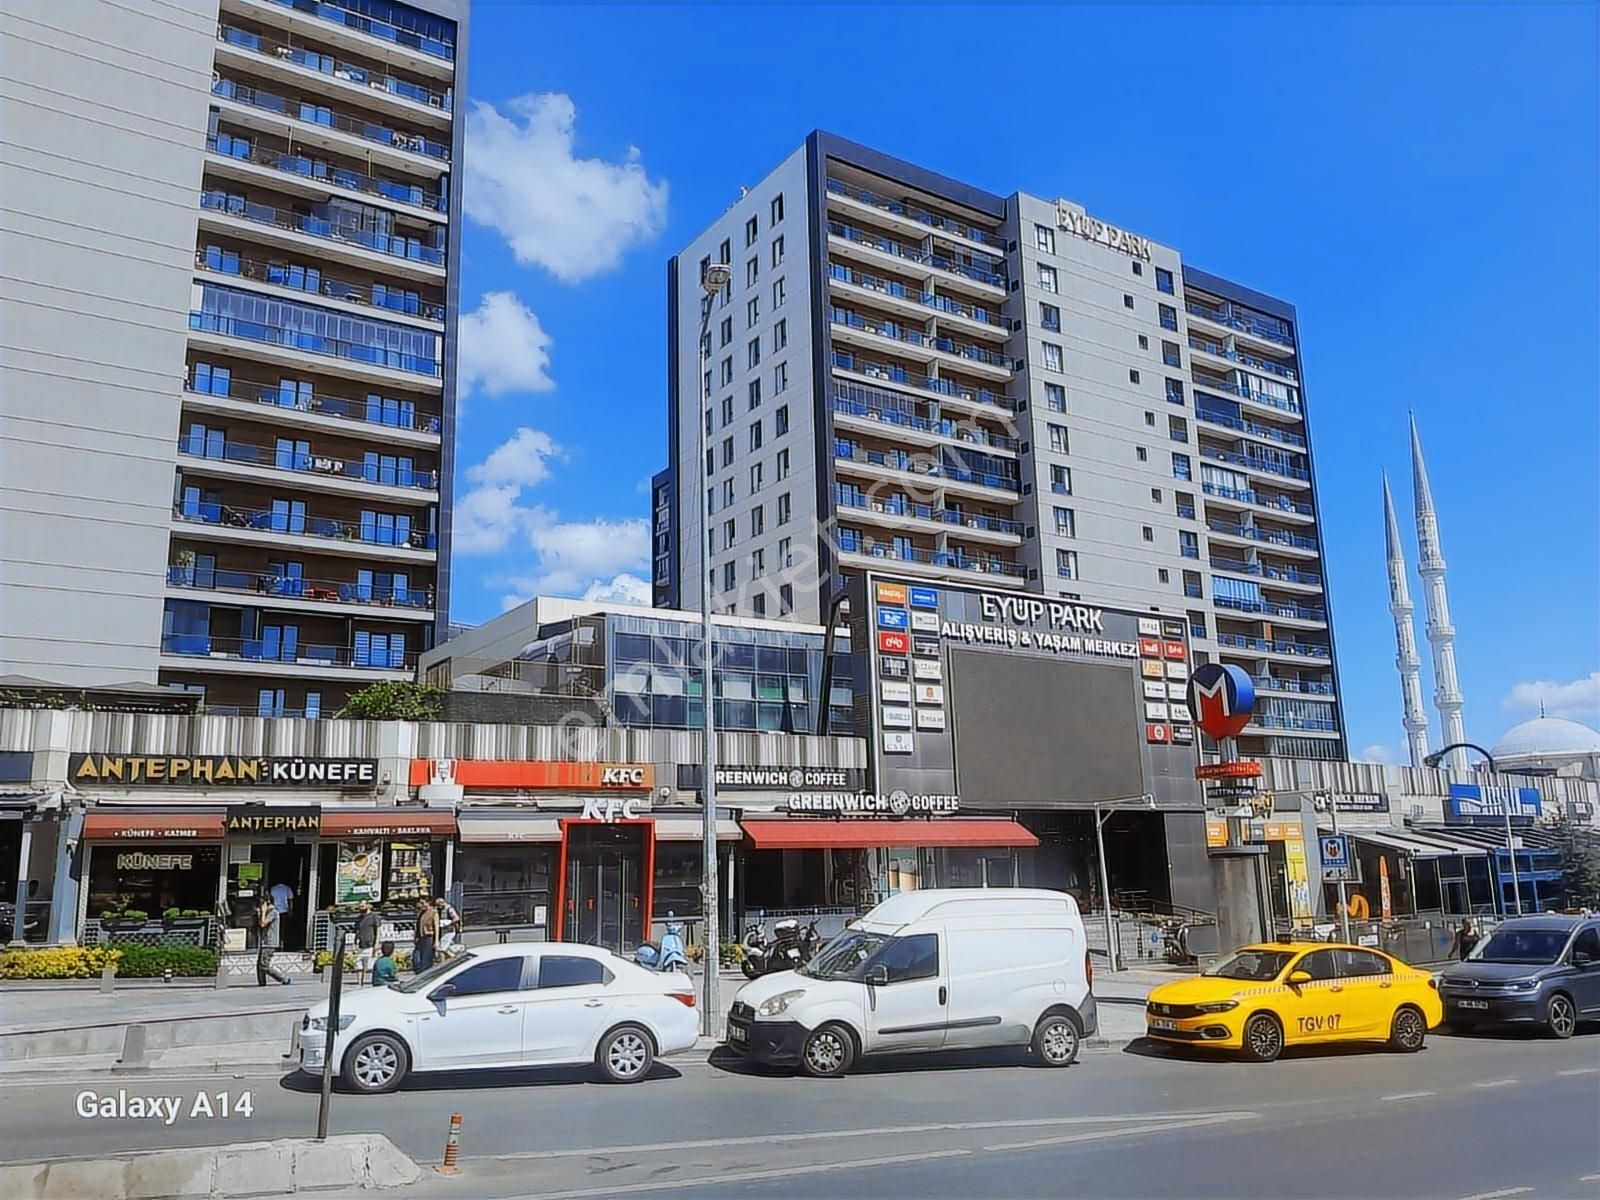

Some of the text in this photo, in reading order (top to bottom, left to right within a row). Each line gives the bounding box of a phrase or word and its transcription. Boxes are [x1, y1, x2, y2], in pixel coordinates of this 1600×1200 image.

[1107, 226, 1151, 261] PARK
[1050, 602, 1103, 631] PARK
[942, 621, 1017, 648] ALIŞVERİŞ
[1021, 631, 1031, 645] &
[1035, 633, 1081, 654] YAŞAM
[76, 755, 372, 784] ANTEPHAN KÜNEFE
[602, 768, 644, 783] KFC
[715, 769, 846, 786] REENWICH COFFEE
[580, 798, 641, 820] KFC
[788, 794, 959, 811] GREENWICH COFFEE
[121, 828, 155, 838] KÜNEFE
[229, 816, 319, 831] ANTEPHAN
[117, 852, 193, 870] KÜNEFE
[1297, 1013, 1342, 1033] TGV 07
